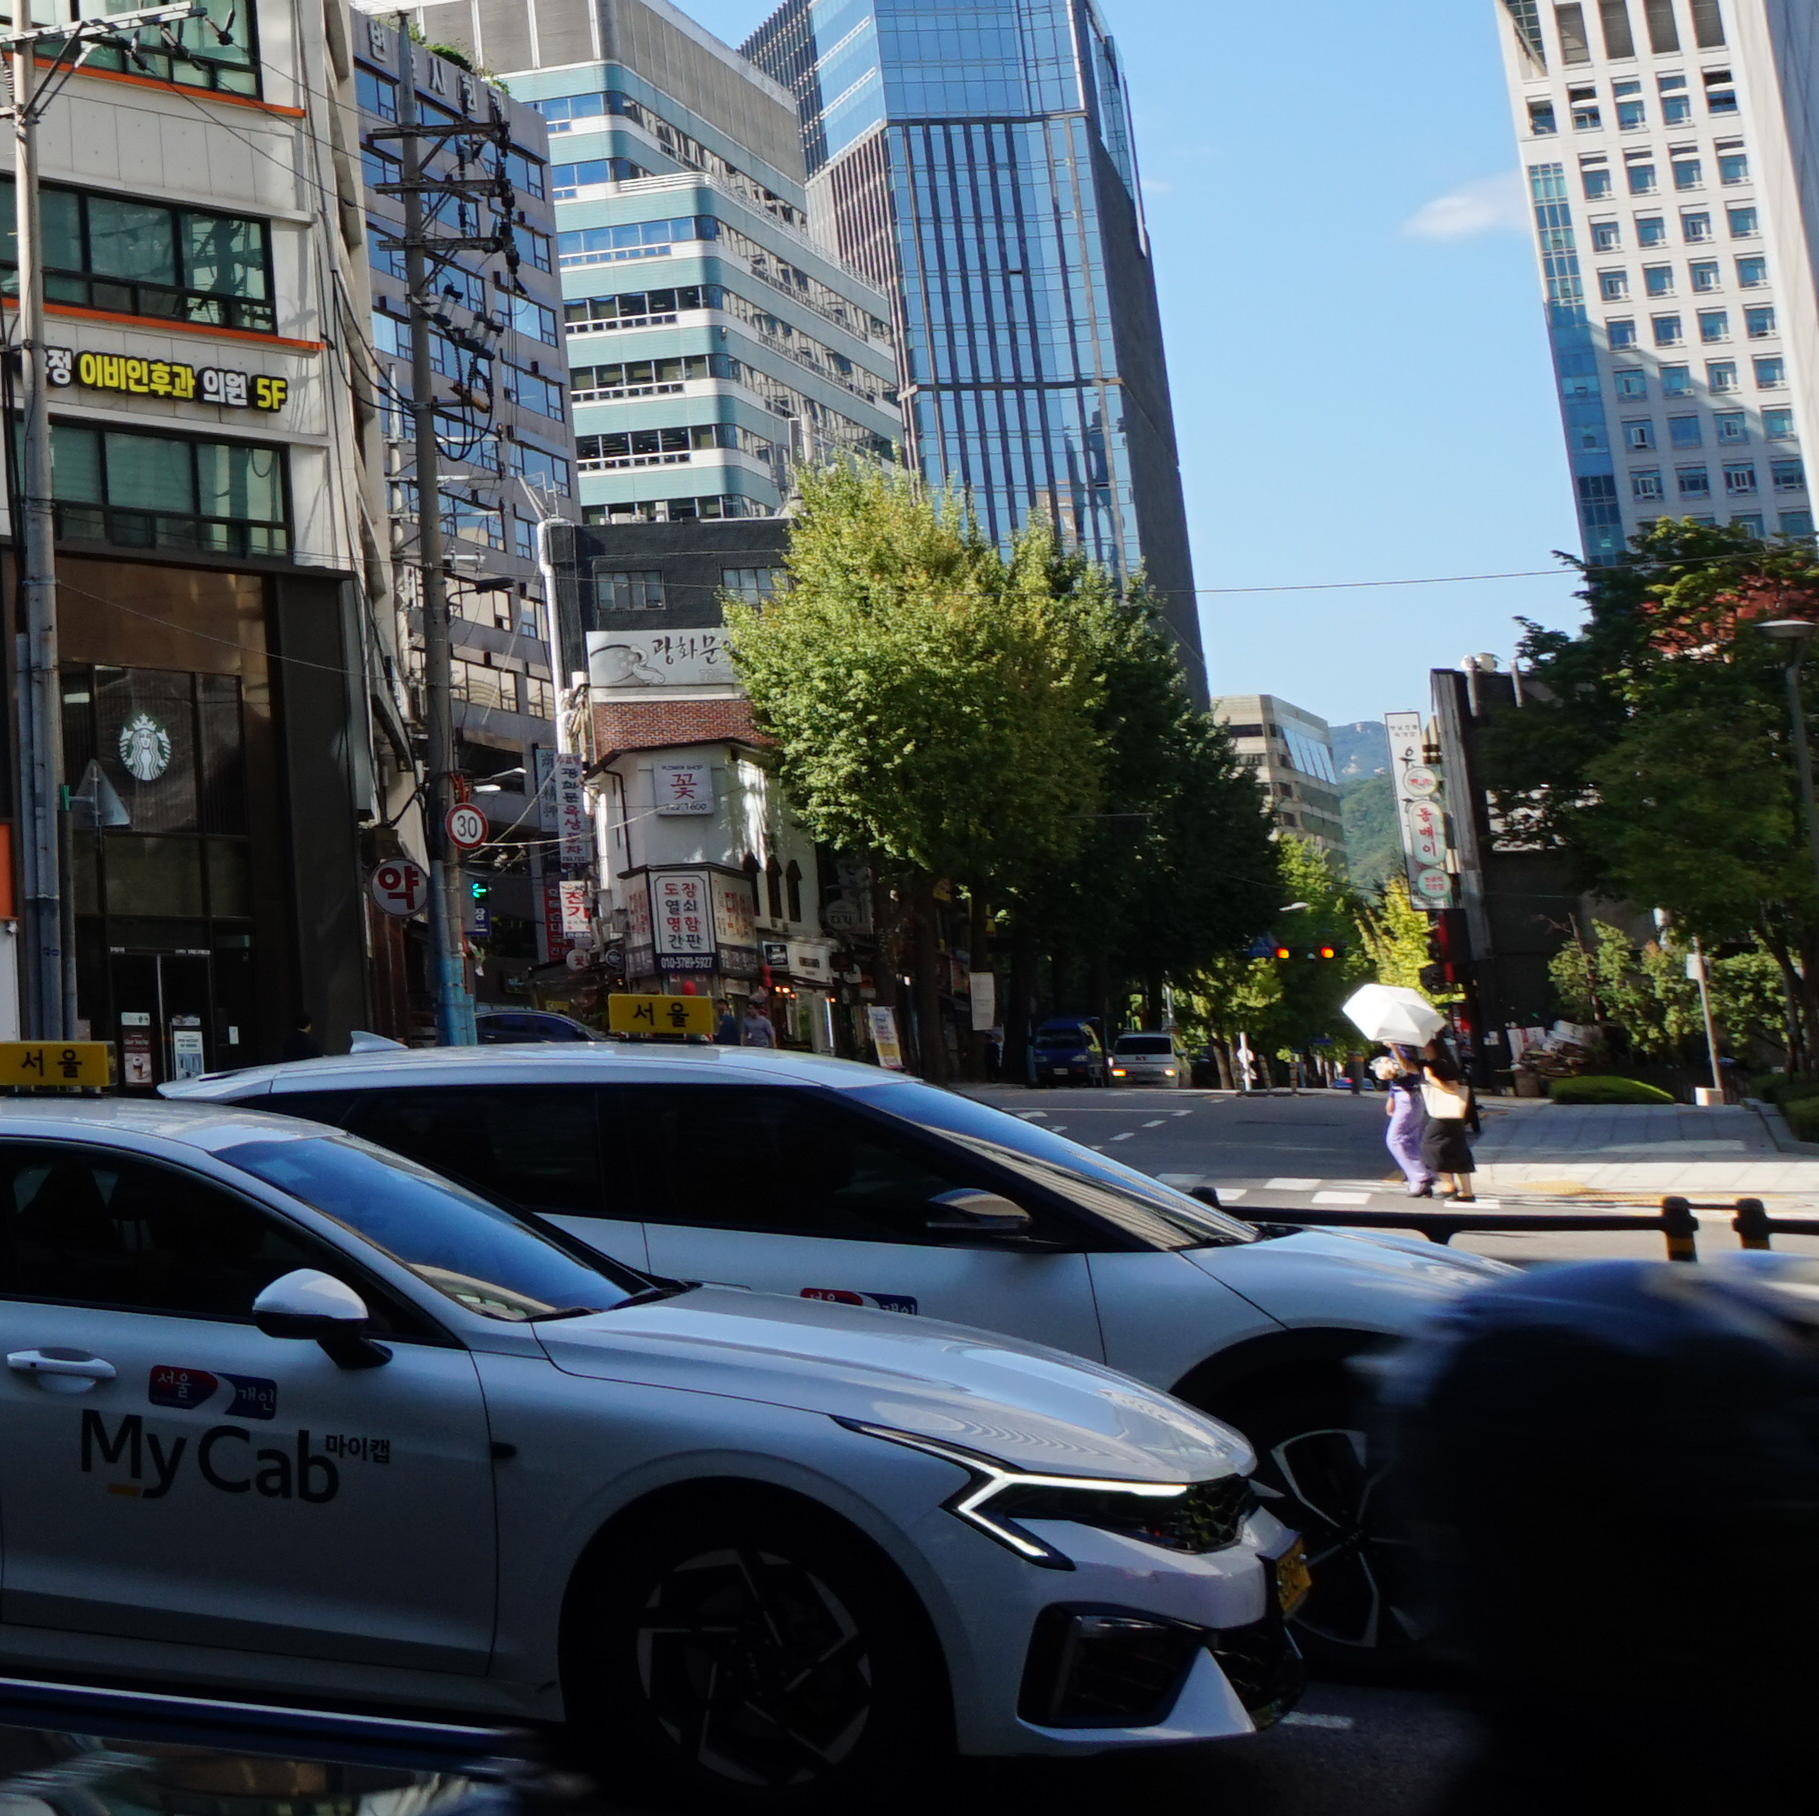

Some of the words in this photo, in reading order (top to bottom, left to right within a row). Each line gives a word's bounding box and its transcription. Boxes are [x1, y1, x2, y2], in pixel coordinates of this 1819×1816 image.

[79, 353, 195, 399] 이비인후과
[203, 370, 248, 406] 의원
[257, 377, 286, 409] 5F
[670, 773, 698, 800] 꽃
[456, 815, 478, 839] 30
[377, 866, 420, 911] 약
[664, 882, 697, 899] 도장
[665, 899, 697, 916] 열쇠
[666, 916, 701, 933] 명함
[668, 934, 702, 950] 간판
[633, 1002, 690, 1027] 서울
[21, 1049, 83, 1078] 서울
[157, 1370, 193, 1399] 서울
[325, 1434, 391, 1465] 마이캡
